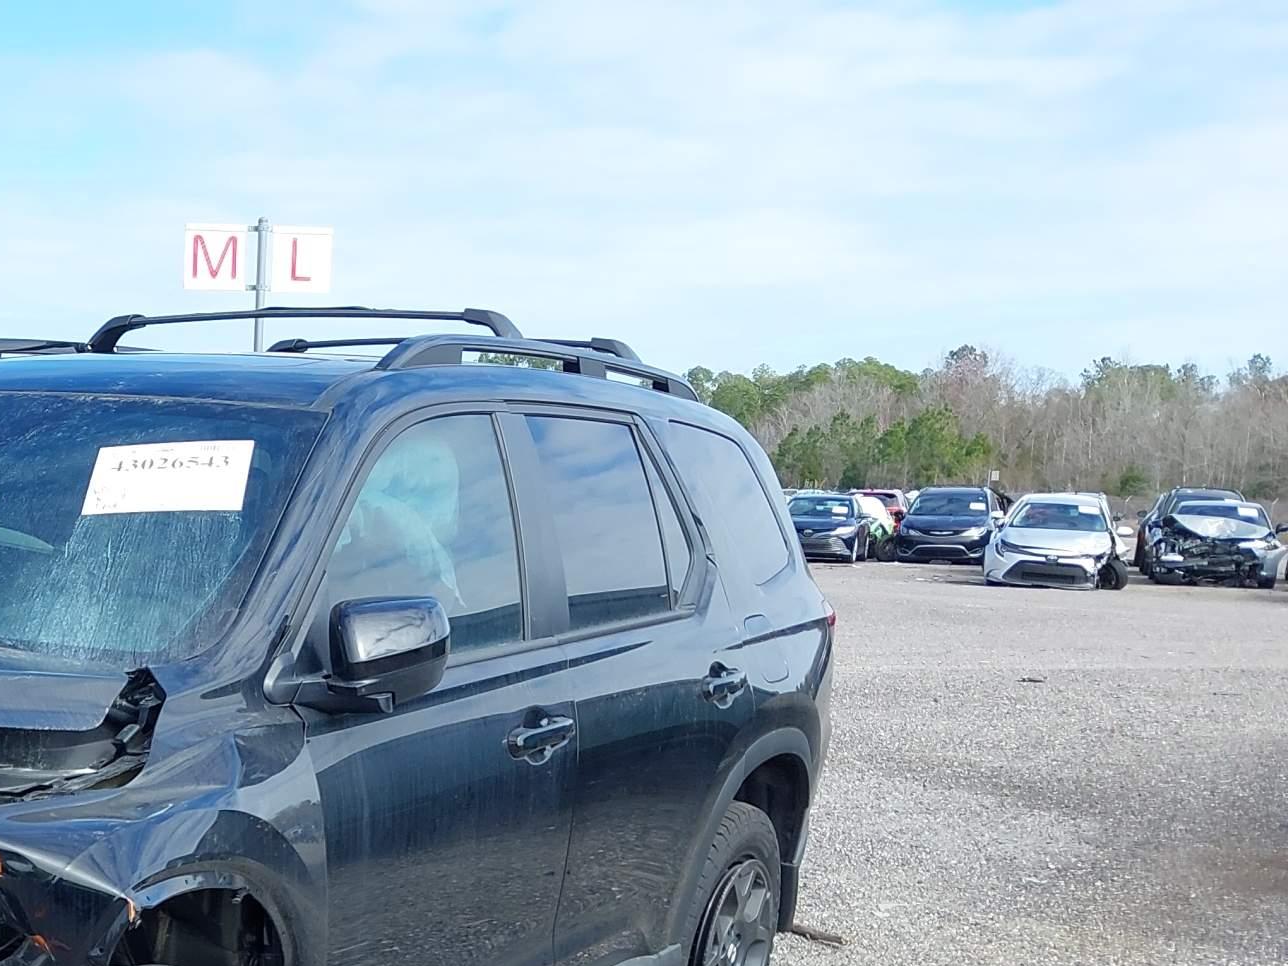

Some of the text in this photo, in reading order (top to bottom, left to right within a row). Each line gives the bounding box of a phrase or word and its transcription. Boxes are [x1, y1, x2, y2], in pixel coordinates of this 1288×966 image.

[192, 235, 238, 279] M
[291, 237, 311, 281] L
[111, 455, 230, 472] 43026543
